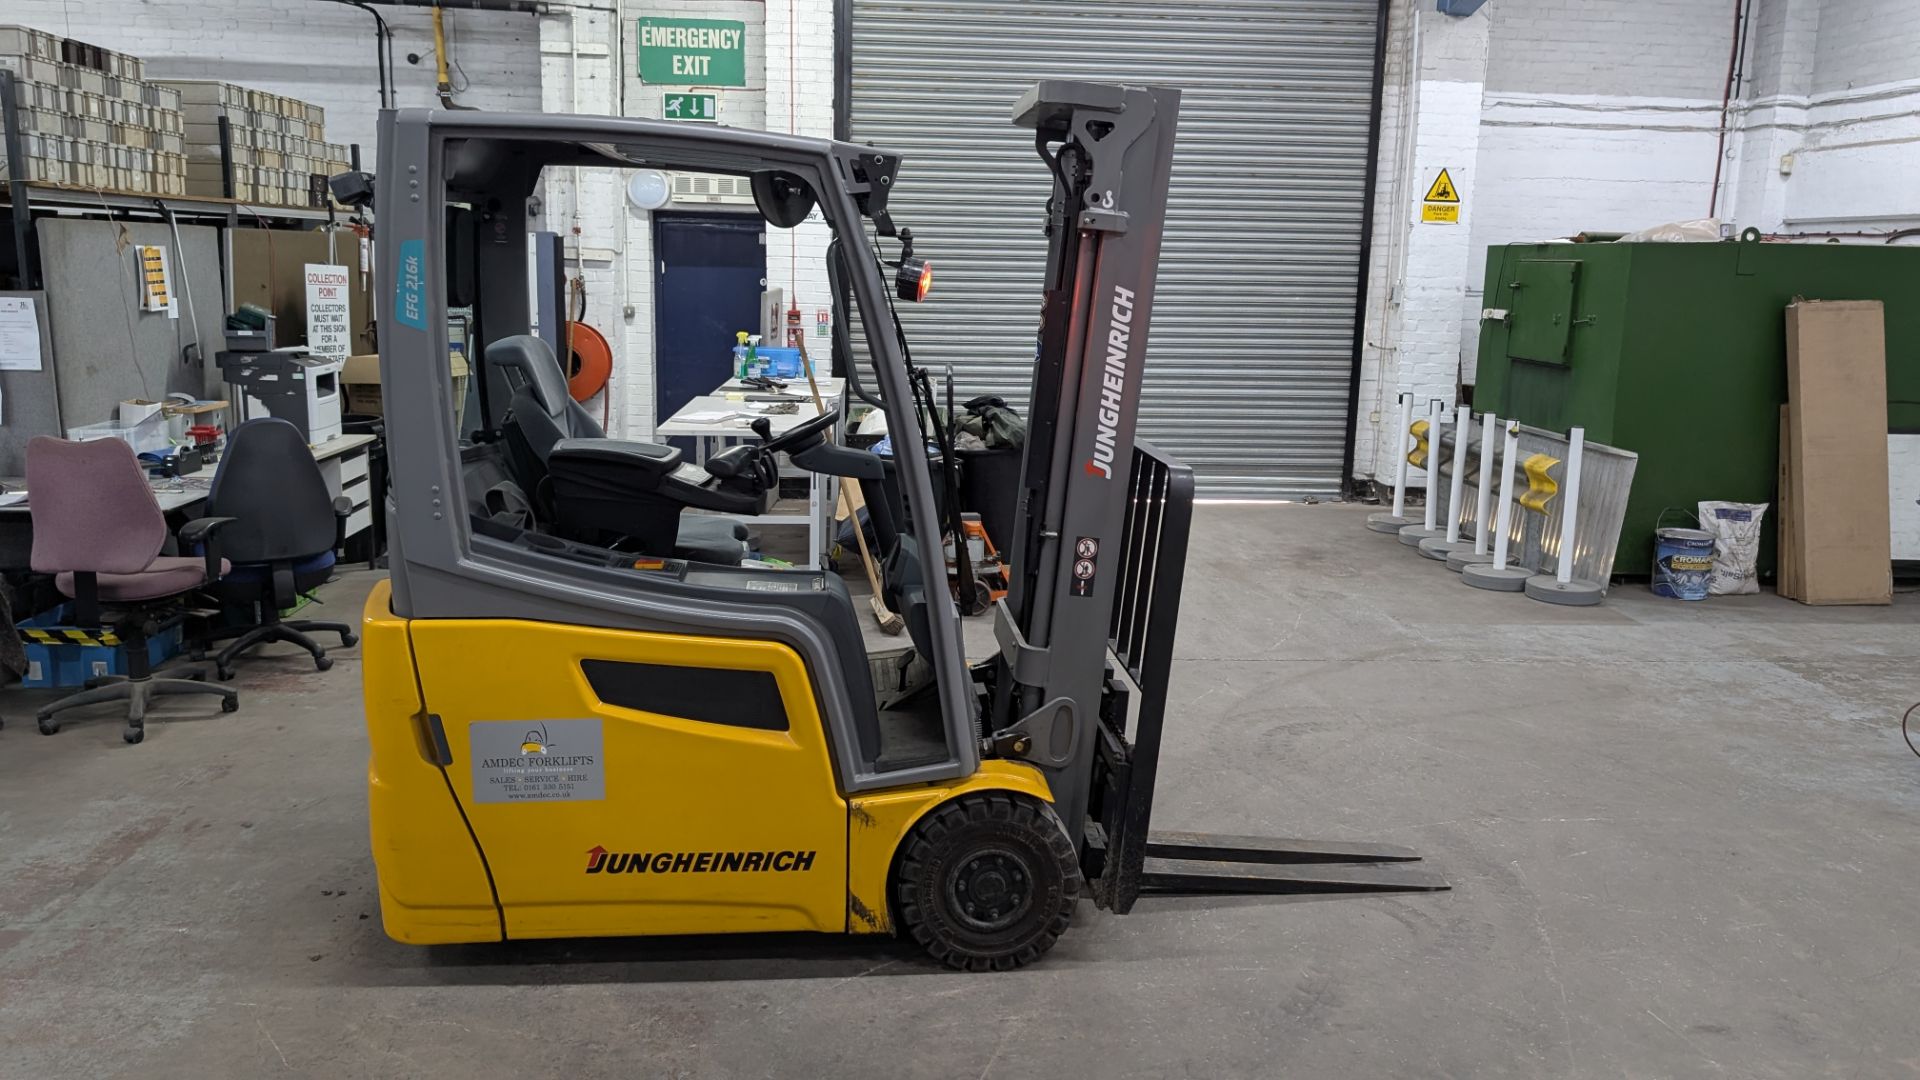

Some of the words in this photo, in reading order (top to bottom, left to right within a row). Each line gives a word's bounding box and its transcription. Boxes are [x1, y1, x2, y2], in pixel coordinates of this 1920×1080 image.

[642, 26, 740, 50] EMERGENCY
[672, 55, 711, 76] EXIT
[308, 273, 347, 284] COLLECTION
[319, 287, 337, 297] POINT
[311, 304, 346, 312] COLLECTORS
[406, 293, 418, 320] EFG
[1088, 284, 1134, 480] JUNGHEINRICH
[482, 758, 525, 768] AMDEC
[528, 756, 594, 767] FORKLIFTS
[586, 848, 816, 874] JUNGHEINRICH
